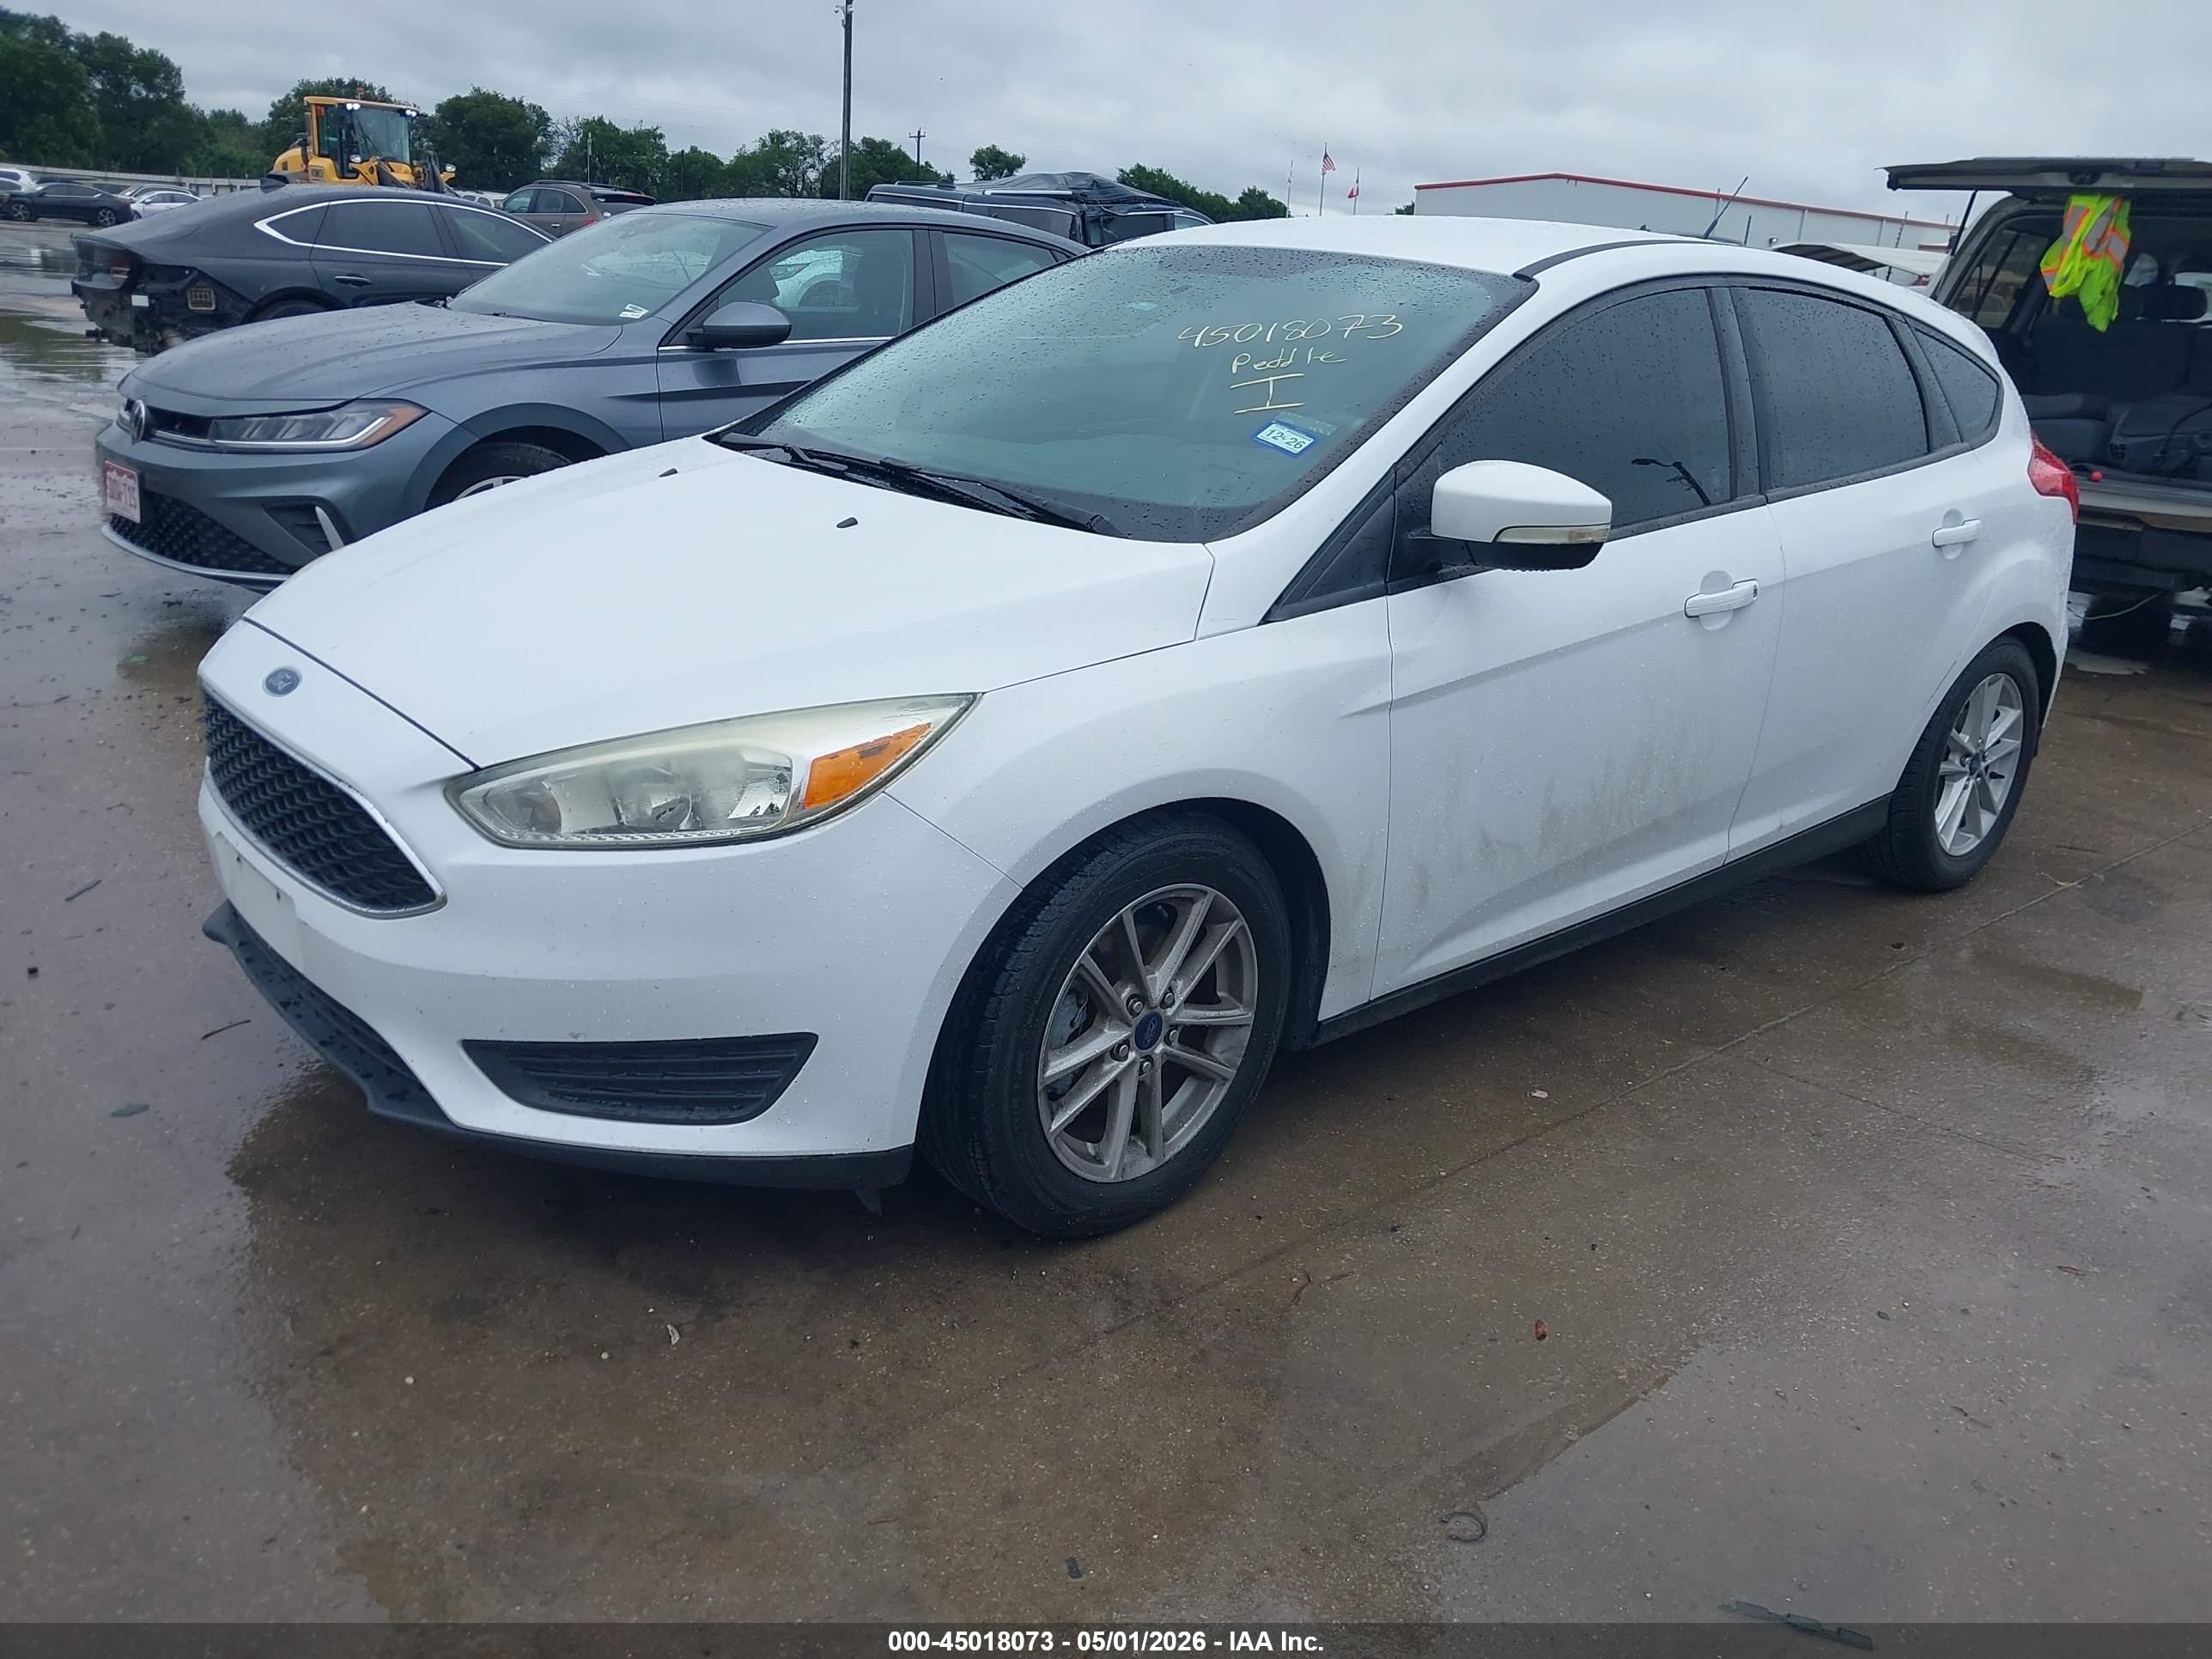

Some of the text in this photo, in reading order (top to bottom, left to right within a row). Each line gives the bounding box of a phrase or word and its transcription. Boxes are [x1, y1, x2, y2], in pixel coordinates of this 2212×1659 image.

[1177, 314, 1403, 348] 45018073
[1266, 429, 1306, 449] 12 26
